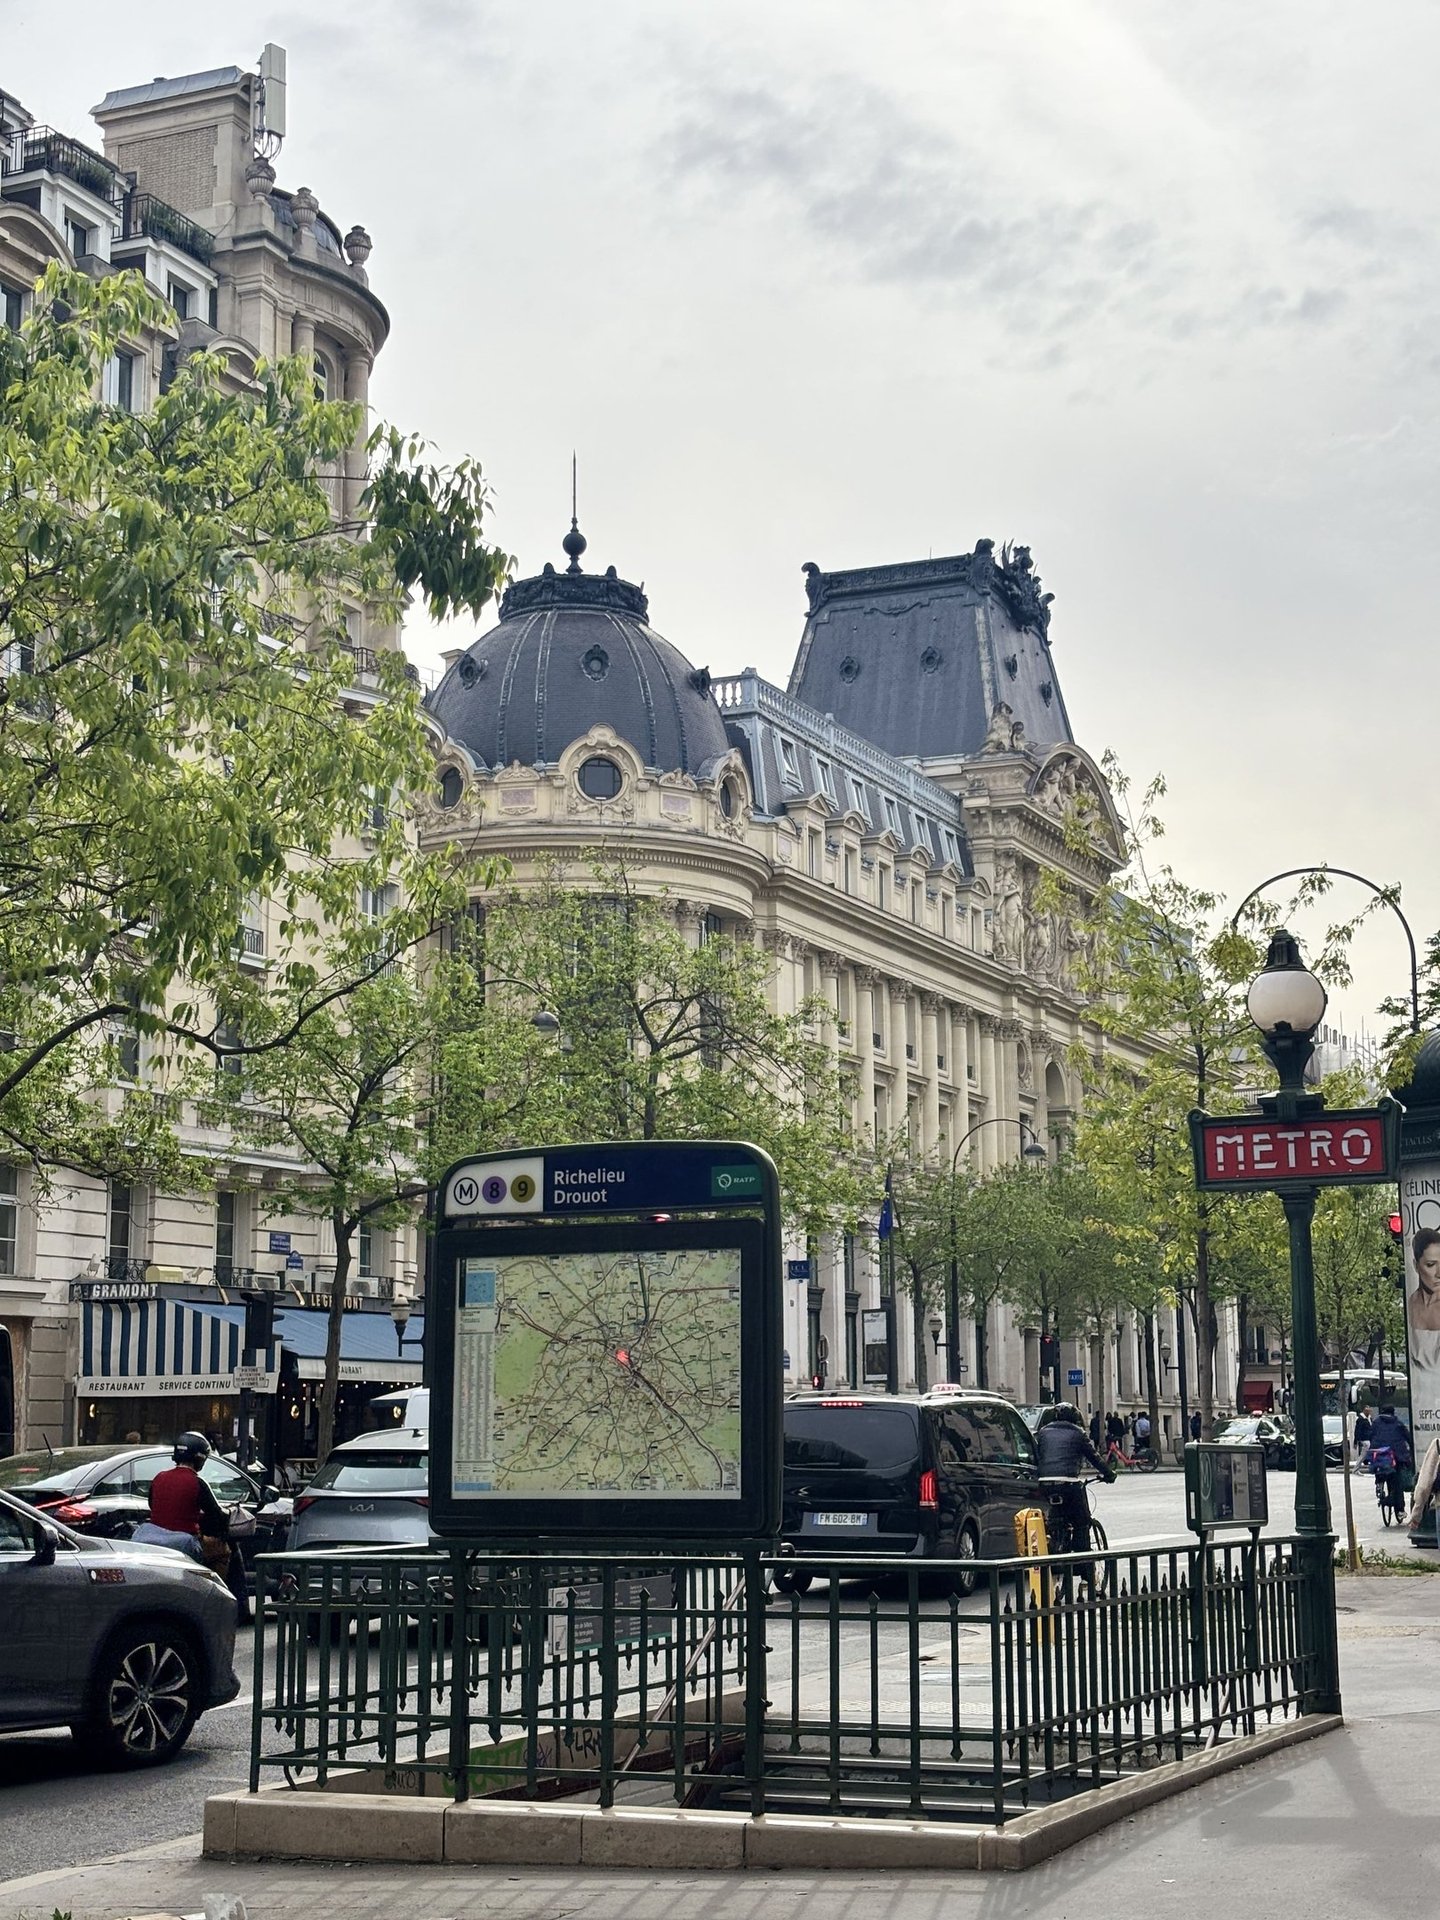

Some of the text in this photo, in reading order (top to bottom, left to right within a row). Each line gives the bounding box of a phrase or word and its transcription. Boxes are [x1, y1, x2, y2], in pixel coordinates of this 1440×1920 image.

[1215, 1128, 1372, 1172] METRO
[553, 1168, 625, 1186] Richelieu
[459, 1180, 529, 1200] M 8 9
[553, 1187, 607, 1205] Drouot
[92, 1283, 158, 1298] GRAMONT
[311, 1293, 363, 1310] LE GRONT
[88, 1382, 146, 1391] RESTAURANT
[159, 1381, 192, 1391] SERVICE
[194, 1380, 231, 1389] CONTINU
